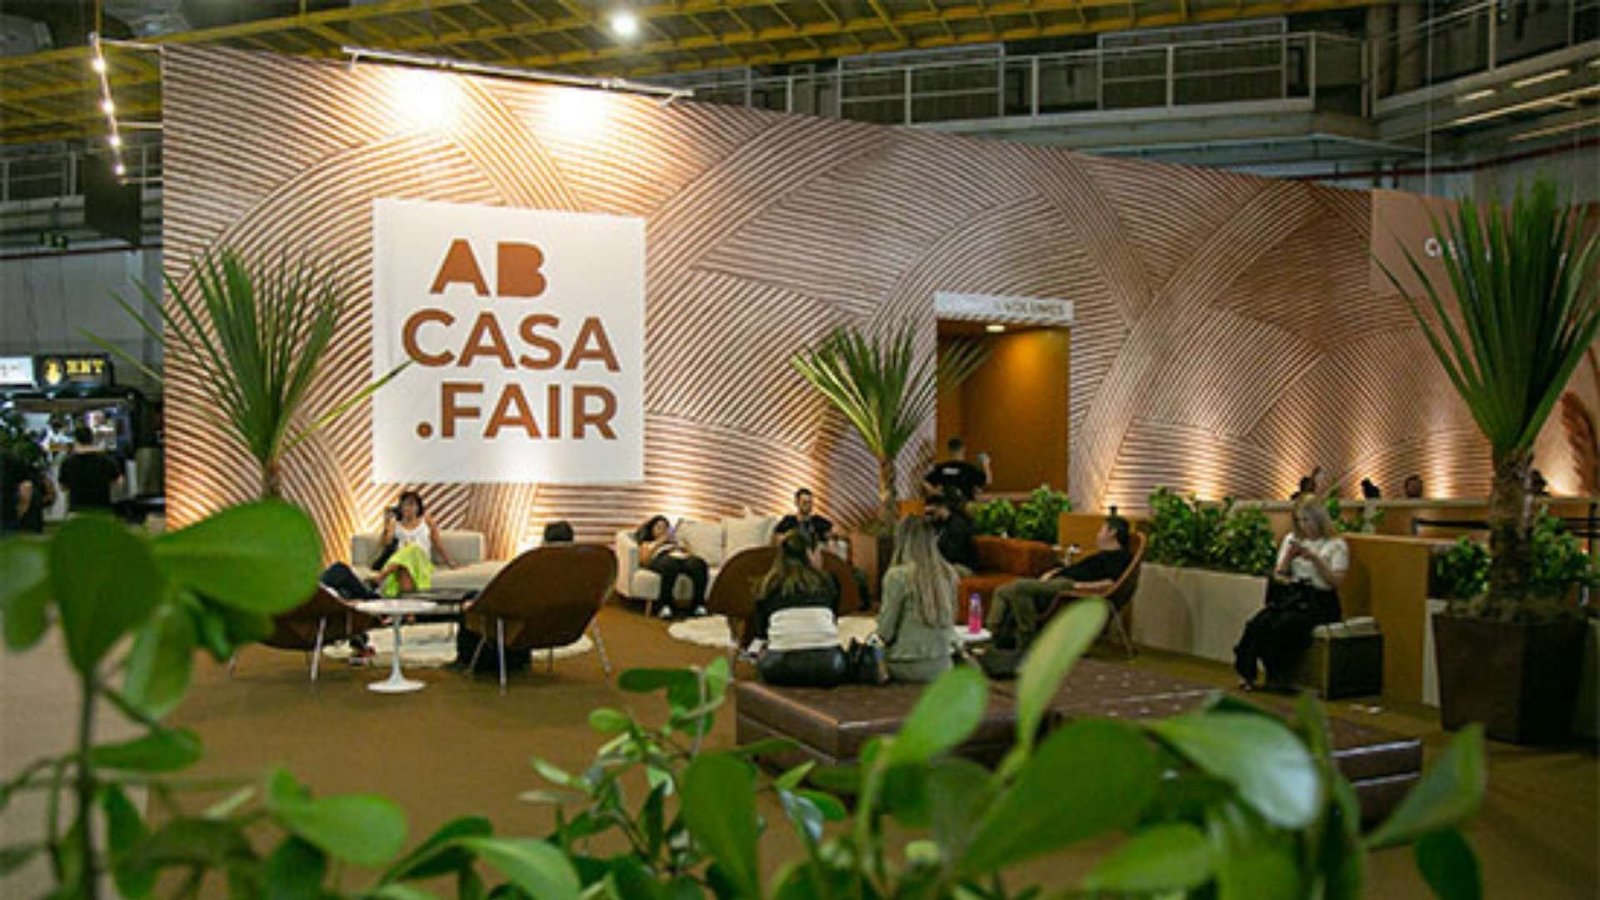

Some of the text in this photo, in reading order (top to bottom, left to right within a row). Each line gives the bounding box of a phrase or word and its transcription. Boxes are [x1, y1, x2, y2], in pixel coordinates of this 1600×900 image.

[430, 238, 548, 297] AB
[402, 308, 621, 372] CASA
[416, 381, 618, 440] .FAIR
